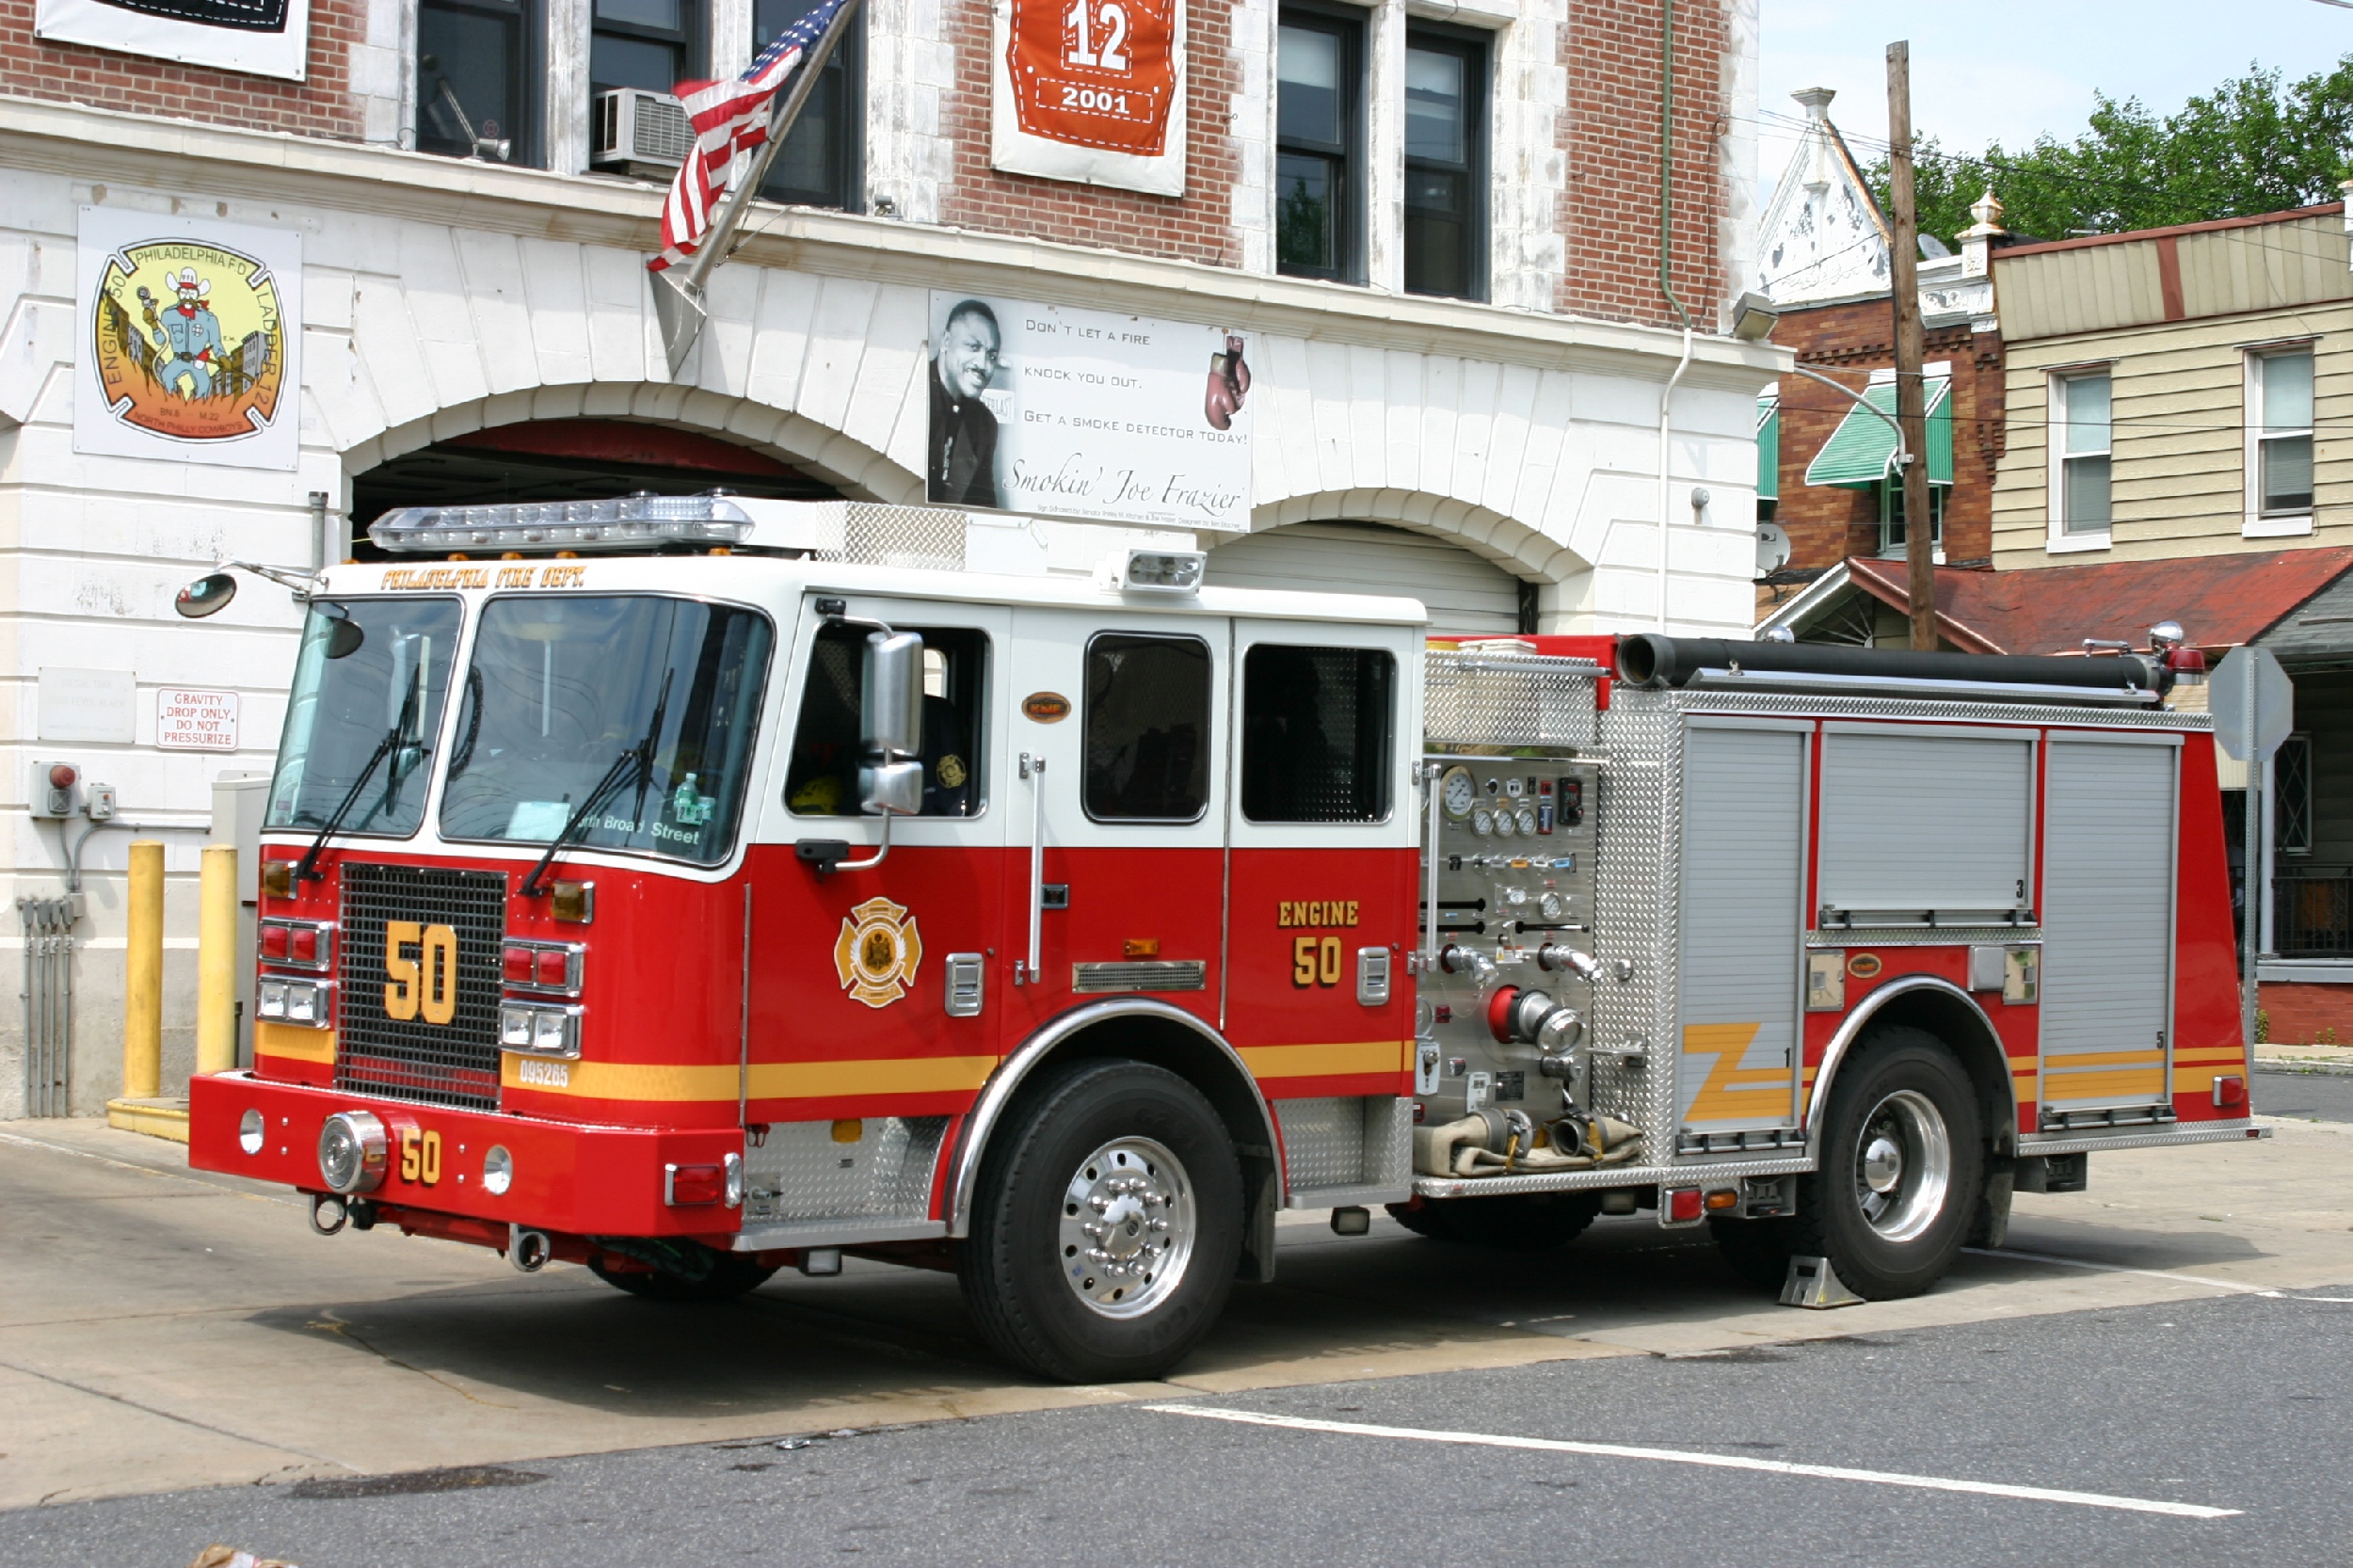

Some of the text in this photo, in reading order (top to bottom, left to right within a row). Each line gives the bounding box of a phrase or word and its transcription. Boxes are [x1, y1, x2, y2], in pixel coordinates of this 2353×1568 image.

[1067, 0, 1127, 71] 12
[1062, 86, 1130, 115] 2001
[135, 247, 226, 268] PHILADELPHIA
[107, 274, 127, 299] 50
[254, 292, 279, 405] LADDER 12
[1078, 328, 1101, 340] LET
[1107, 331, 1116, 341] A
[1121, 333, 1151, 345] FIRE
[1024, 366, 1143, 389] KNOCK YOU OUT.
[134, 411, 245, 434] NORTH PHILLY COWBOYS
[1024, 409, 1248, 445] GET A SMOKE DETECTOR TODAY!
[1001, 452, 1241, 517] Smokin' Joe Frazier
[381, 565, 587, 591] PHILADELPHIA FIRE DEPT.
[174, 693, 224, 706] GRAVITY
[166, 706, 231, 720] DROP ONLY
[176, 719, 220, 732] DO NOT
[164, 731, 232, 745] PRESSURIZE
[603, 815, 645, 833] Broad
[650, 822, 699, 845] Street
[2016, 879, 2024, 899] 3
[1278, 900, 1359, 928] ENGINE
[384, 920, 457, 1025] 50
[1293, 936, 1342, 986] 50
[2156, 1031, 2164, 1049] 5
[1784, 1047, 1791, 1067] 1
[520, 1059, 569, 1088] 095265
[401, 1127, 441, 1185] 50
